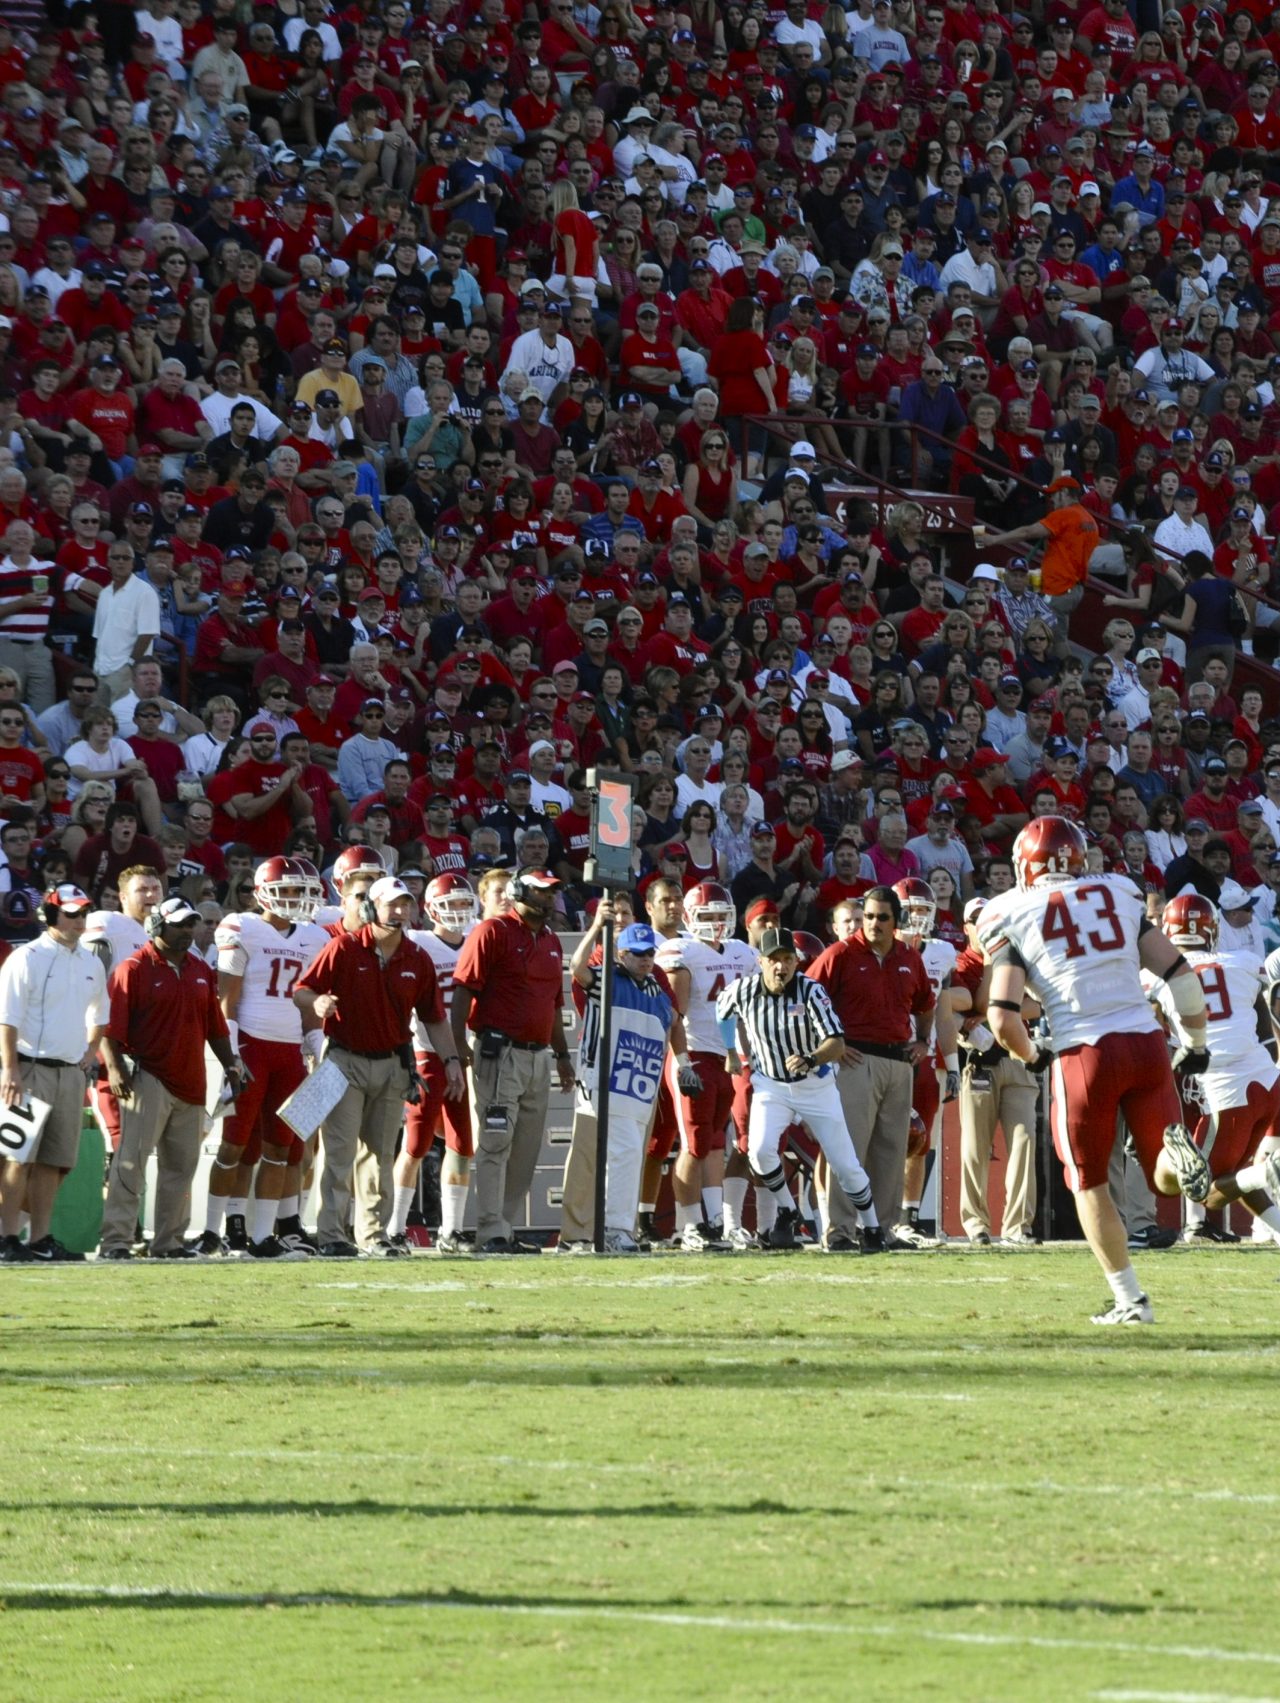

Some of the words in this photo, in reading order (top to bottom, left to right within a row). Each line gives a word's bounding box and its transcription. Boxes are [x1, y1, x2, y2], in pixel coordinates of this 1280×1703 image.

[599, 780, 631, 847] 3
[1047, 856, 1069, 873] 43
[1042, 884, 1126, 959] 43
[1189, 920, 1197, 934] 9
[263, 947, 296, 957] WASHINGTON
[266, 958, 303, 998] 17
[705, 964, 732, 972] WASHINGTON
[1194, 962, 1233, 1022] 9
[616, 1048, 661, 1077] PAC
[614, 1068, 656, 1101] 10
